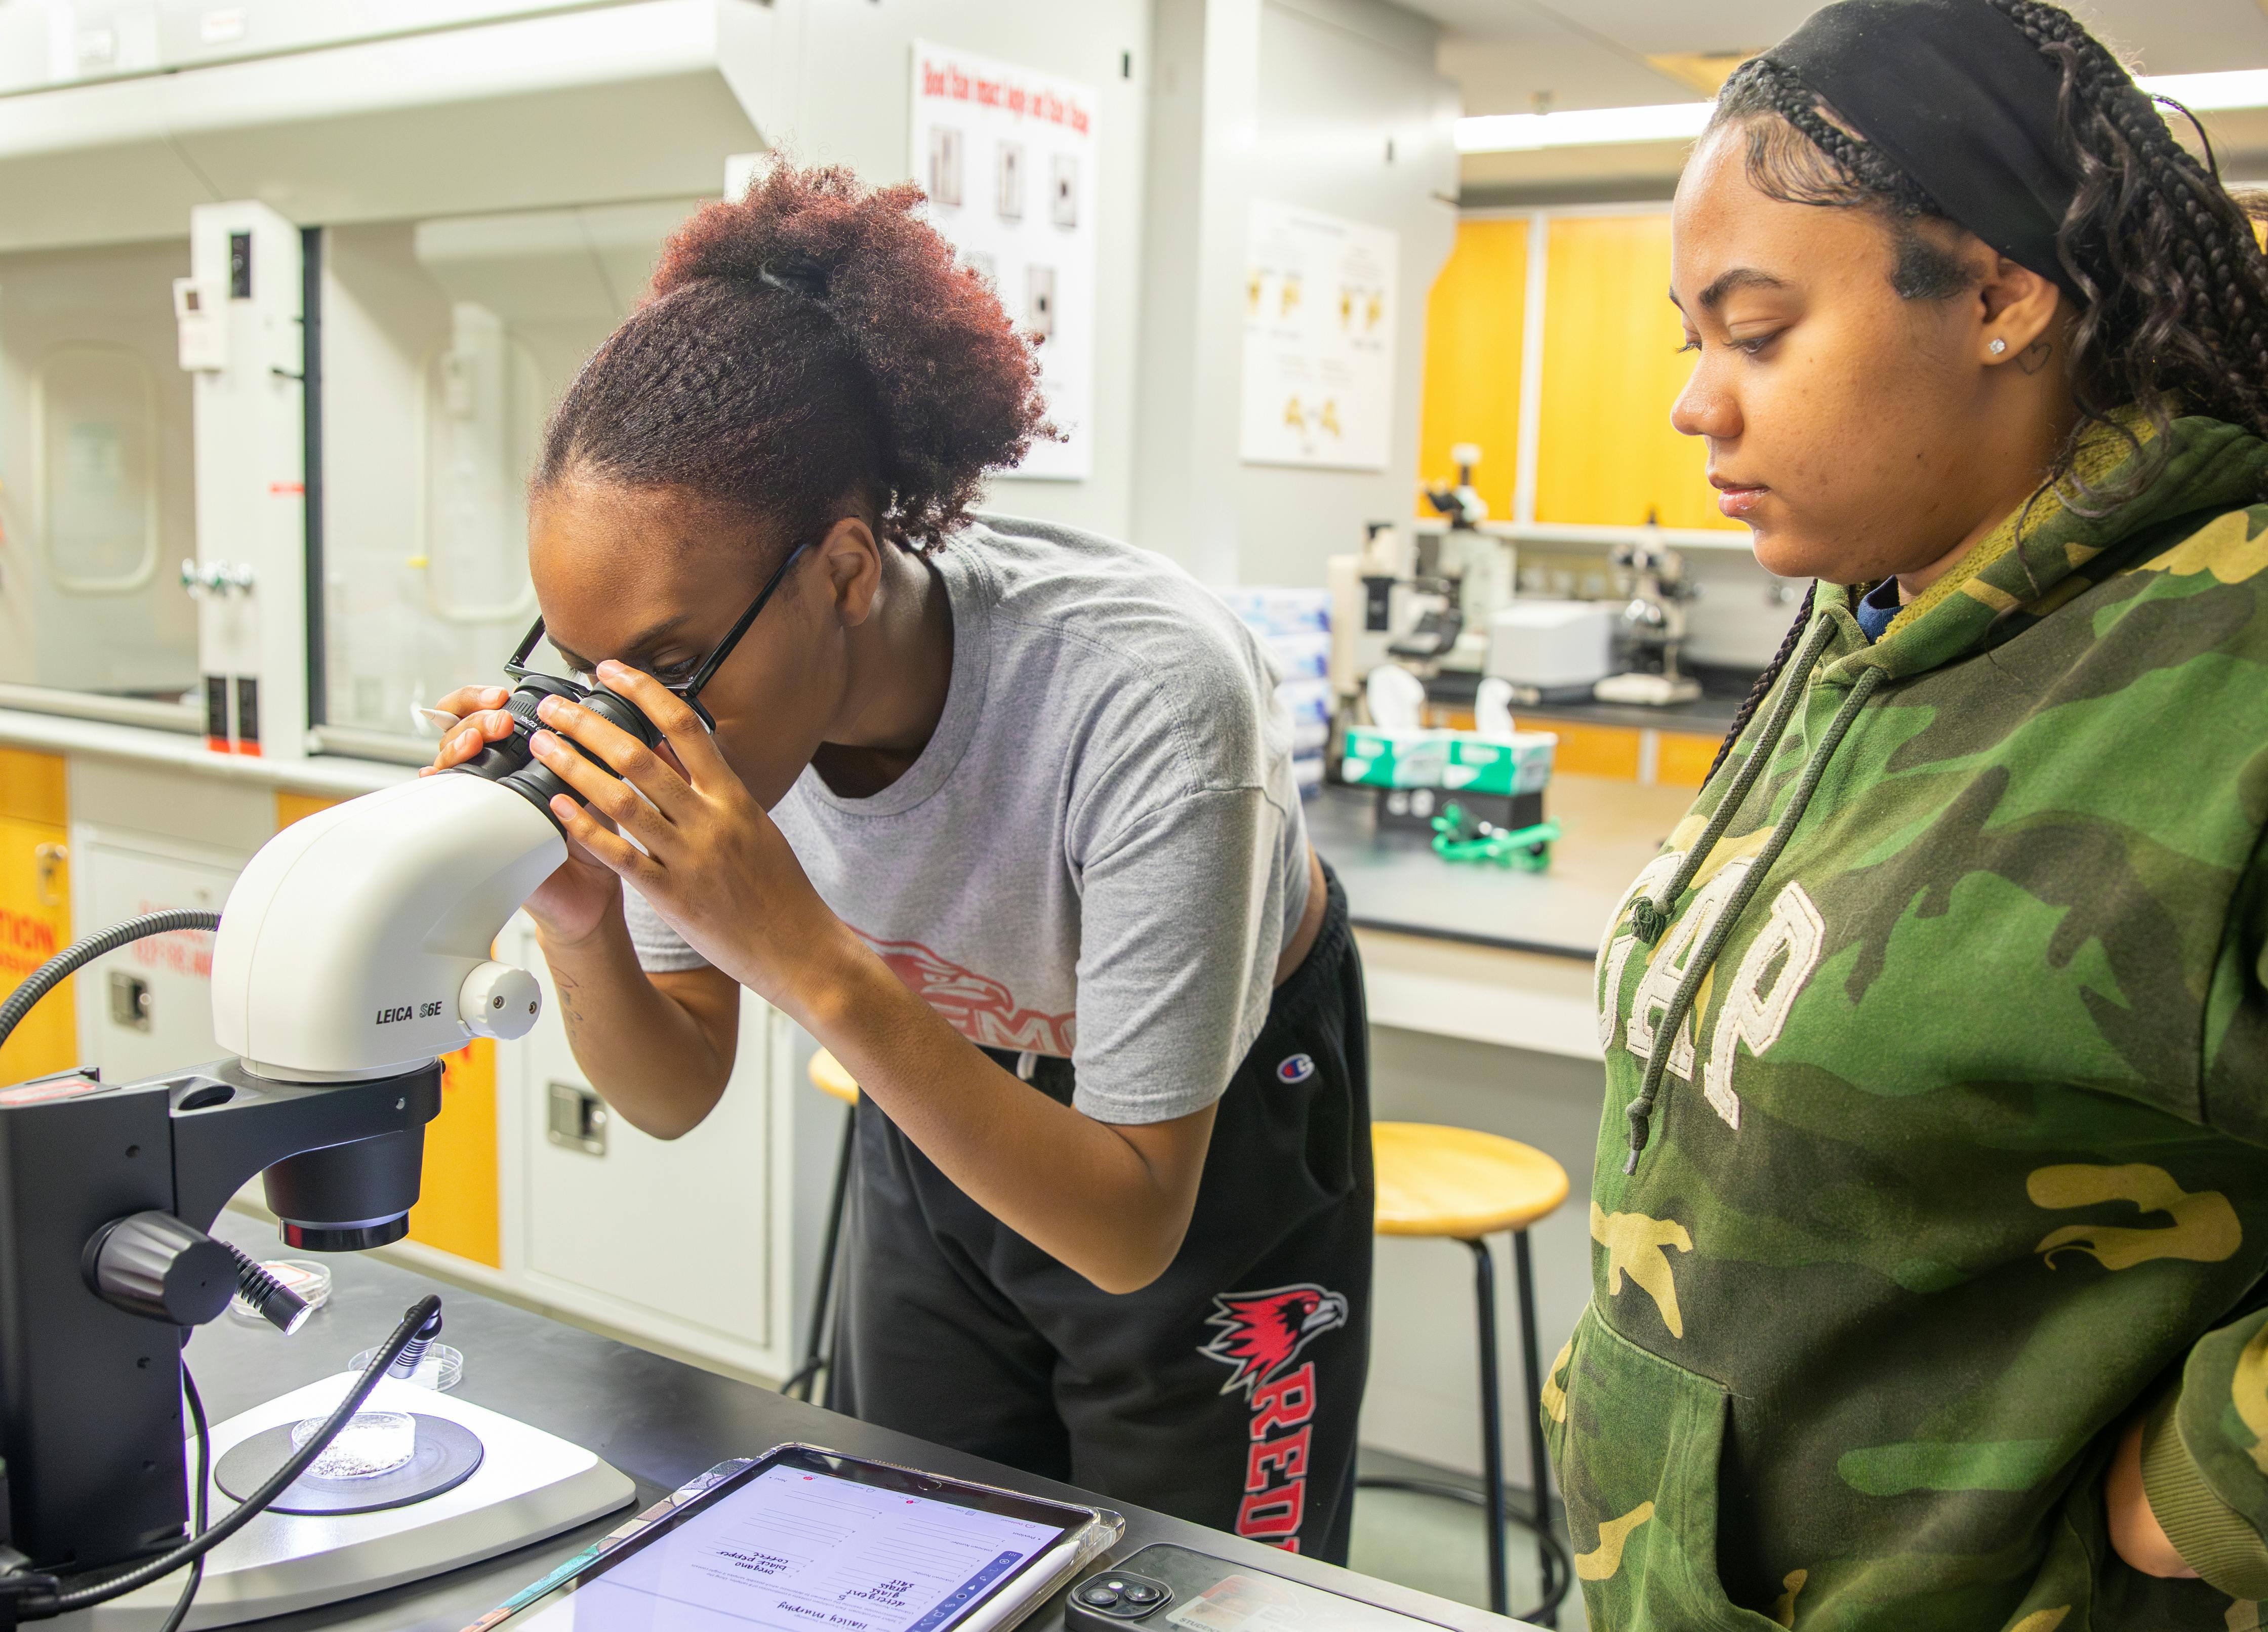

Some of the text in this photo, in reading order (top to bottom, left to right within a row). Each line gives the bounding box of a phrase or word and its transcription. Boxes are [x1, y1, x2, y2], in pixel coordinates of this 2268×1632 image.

[376, 1001, 442, 1025] LEICA S6E
[716, 1551, 787, 1571] black pepper
[753, 1552, 788, 1564] coffee
[735, 1562, 774, 1575] oregano
[878, 1583, 907, 1593] grass
[889, 1580, 915, 1588] salt
[845, 1589, 905, 1607] detergent
[870, 1588, 900, 1598] glass
